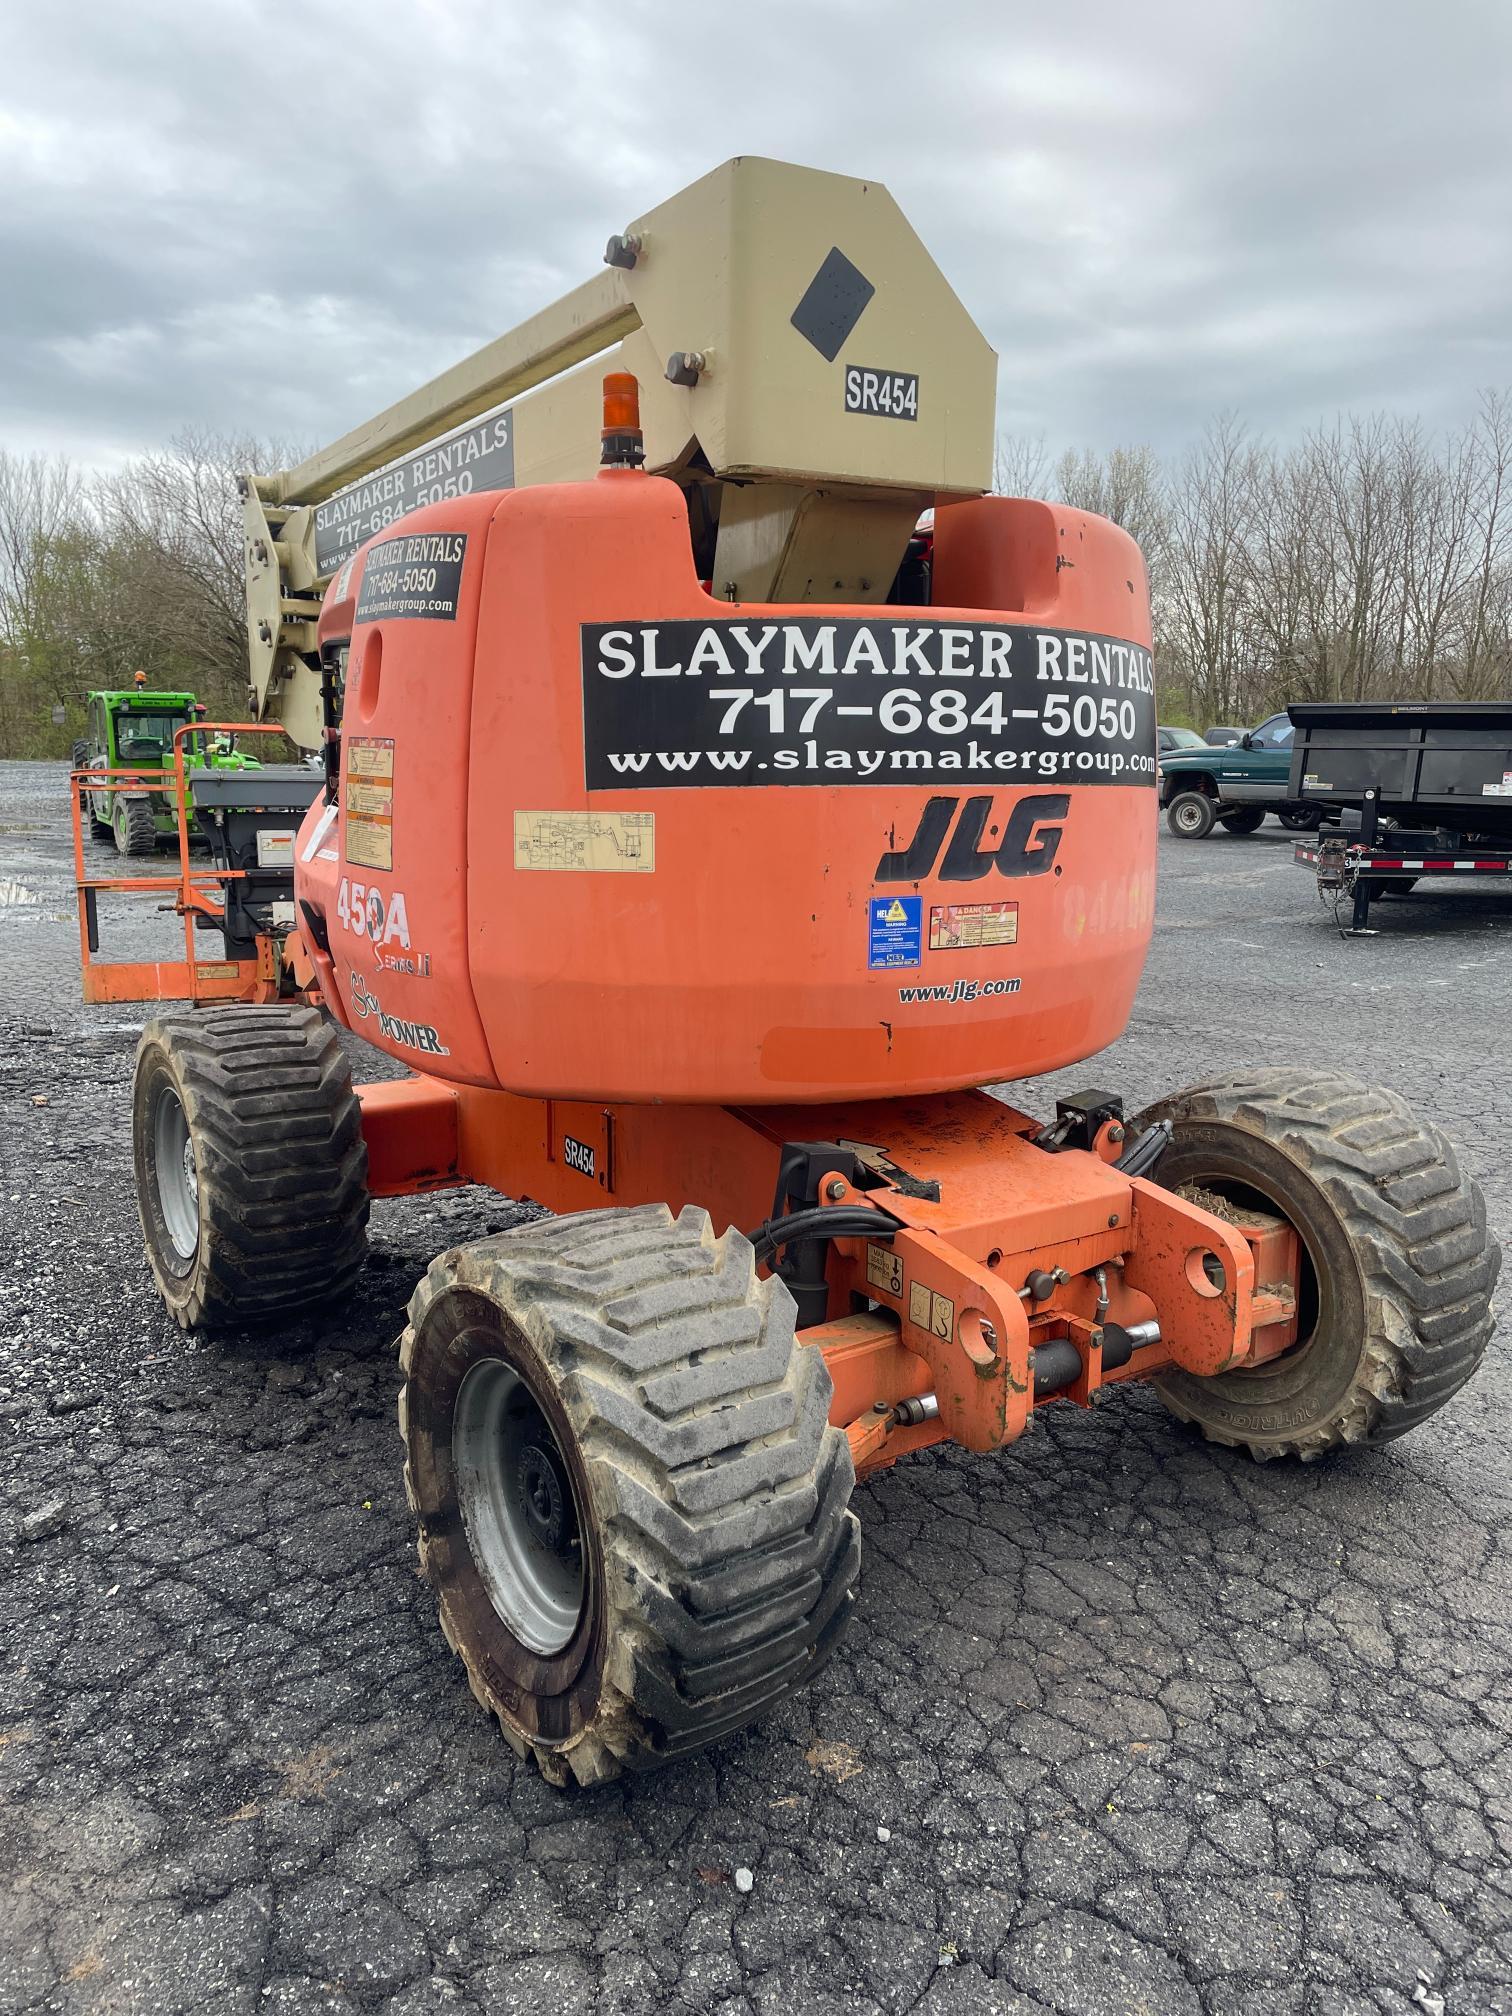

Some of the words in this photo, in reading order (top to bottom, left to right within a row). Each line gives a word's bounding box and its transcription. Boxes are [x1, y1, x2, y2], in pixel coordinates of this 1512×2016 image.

[846, 370, 917, 416] SR454
[316, 470, 405, 531] SLAYMAKER
[412, 419, 508, 487] RENTALS
[405, 537, 463, 562] RENTALS
[368, 568, 437, 597] 717-684-5050
[358, 597, 453, 615] www.slaymakergroup.com
[598, 626, 1013, 678] SLAYMAKER
[1036, 635, 1154, 696] RENTALS
[709, 687, 1136, 740] 717-684-5050
[607, 740, 1155, 776] www.slaymakergroup.com
[875, 794, 1072, 882] JLG
[337, 877, 411, 950] 450A
[964, 906, 992, 914] DANGER
[900, 978, 1021, 1003] www.jlg.com
[565, 1137, 594, 1176] SR454
